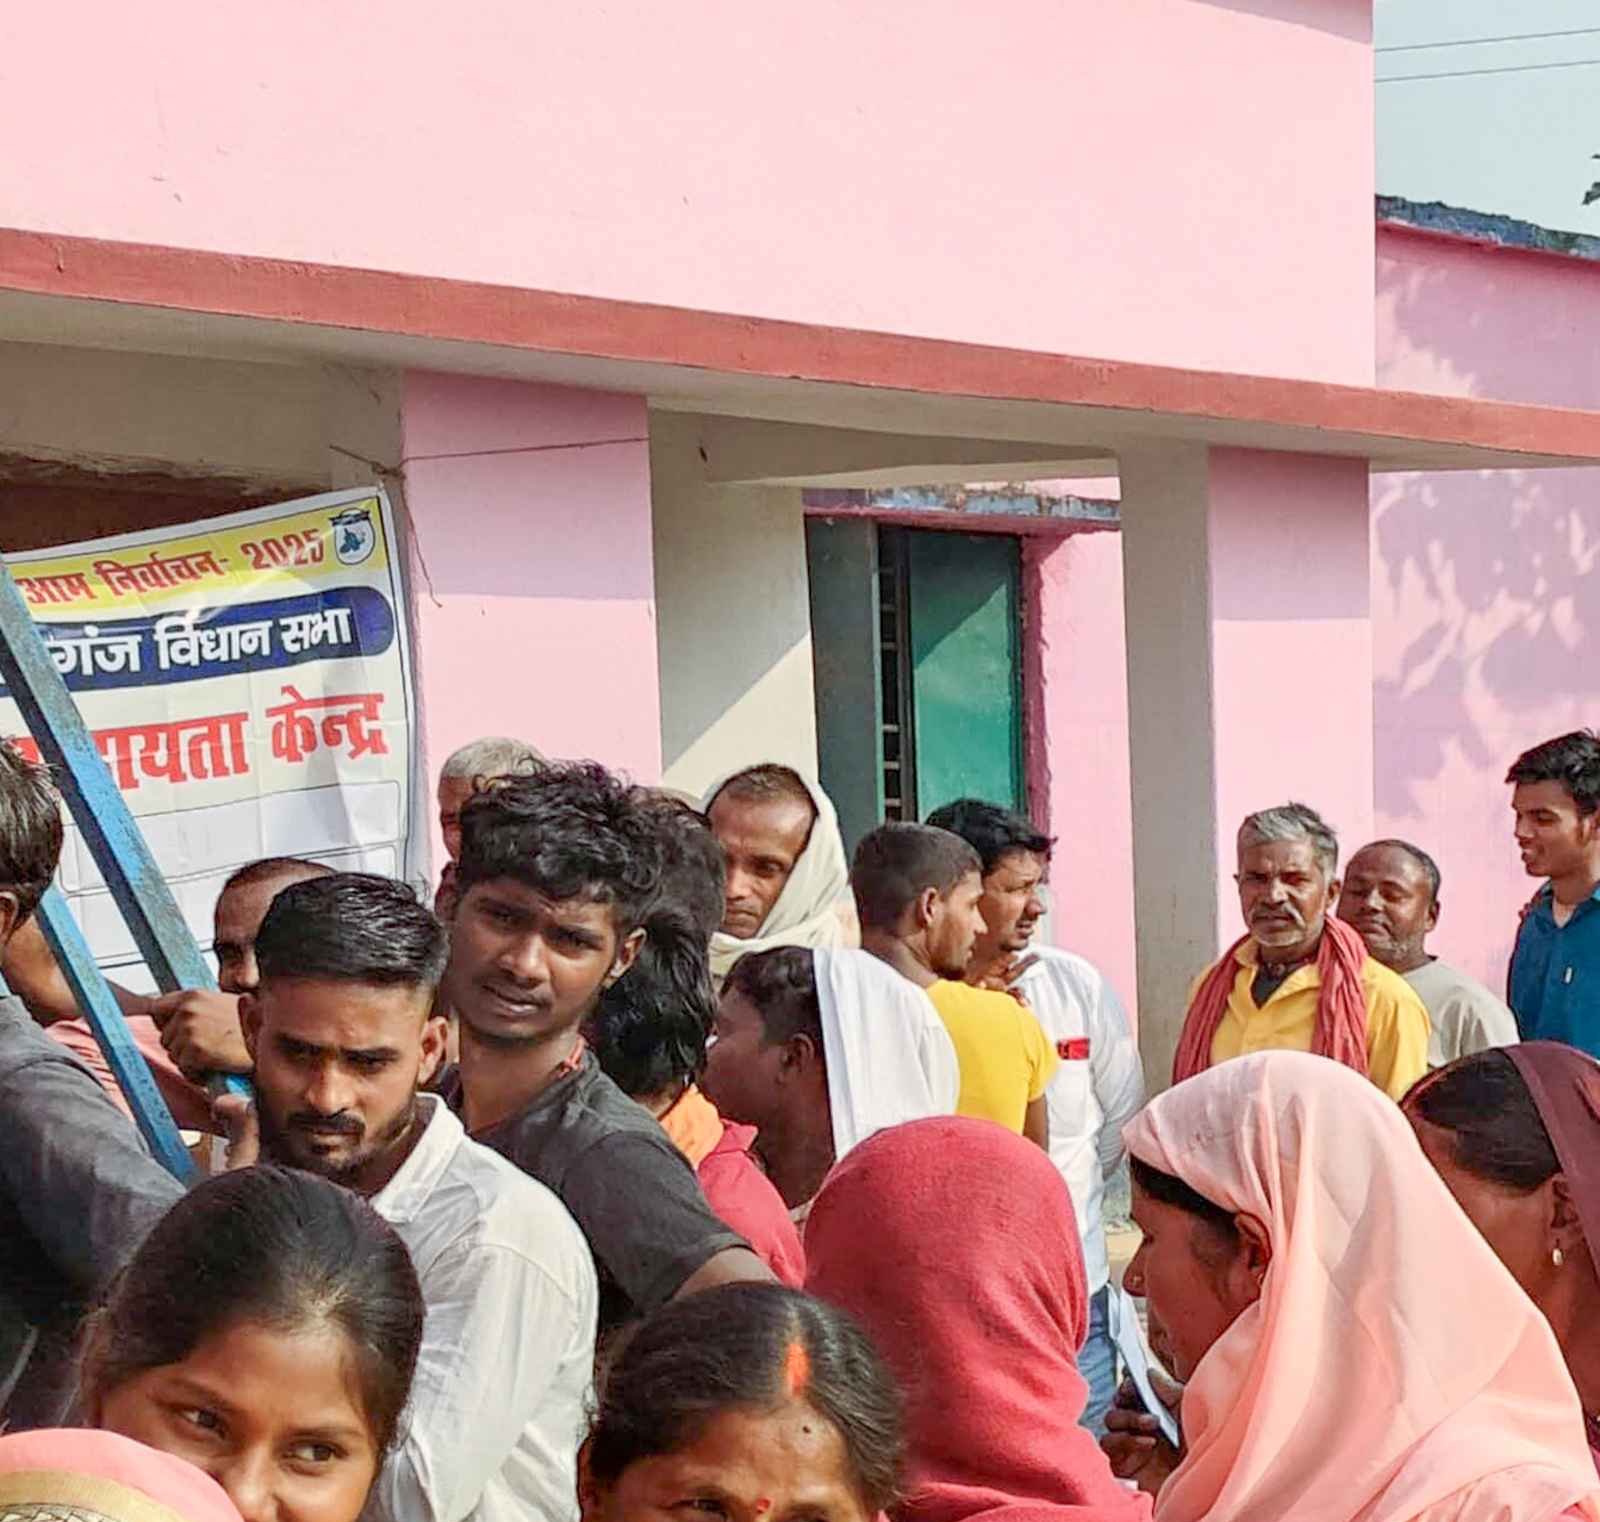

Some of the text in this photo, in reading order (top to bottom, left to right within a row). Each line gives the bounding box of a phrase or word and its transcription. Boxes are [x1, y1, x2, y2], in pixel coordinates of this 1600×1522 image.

[15, 571, 96, 606] आम
[241, 528, 324, 572] 2025
[45, 607, 352, 677] गंज विधान सभा
[265, 684, 388, 764] केन्द्र
